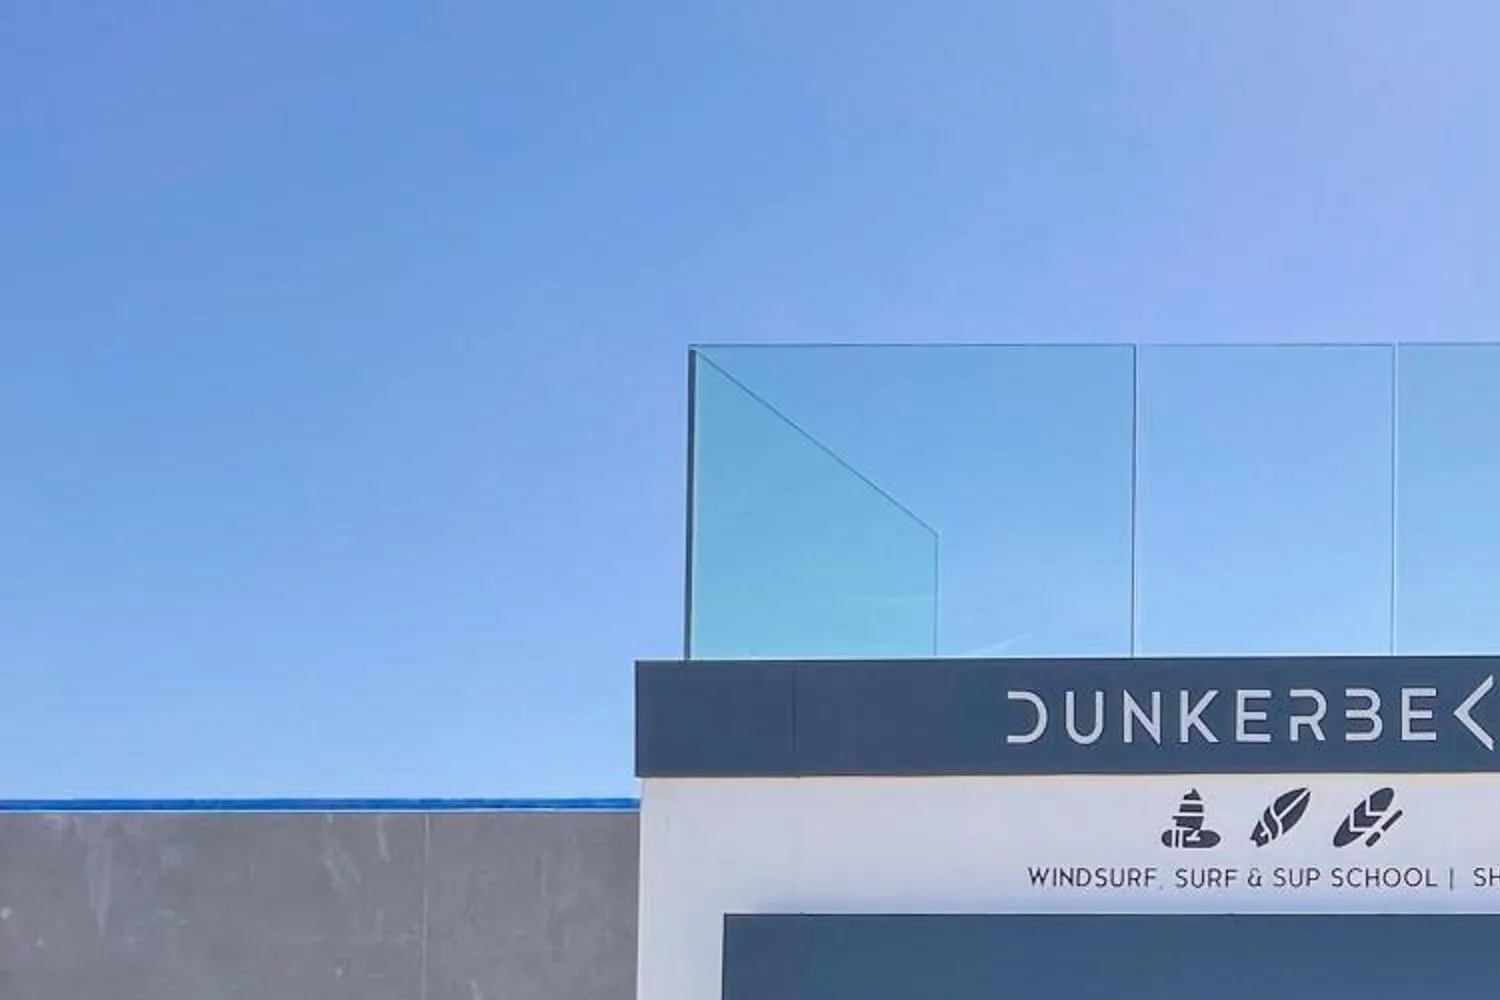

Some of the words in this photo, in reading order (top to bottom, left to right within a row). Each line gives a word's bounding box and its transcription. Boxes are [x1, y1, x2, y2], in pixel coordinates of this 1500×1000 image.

[1175, 867, 1239, 889] SURF
[1247, 867, 1264, 888] &
[1273, 867, 1321, 889] SUP
[1331, 867, 1438, 888] SCHOOL
